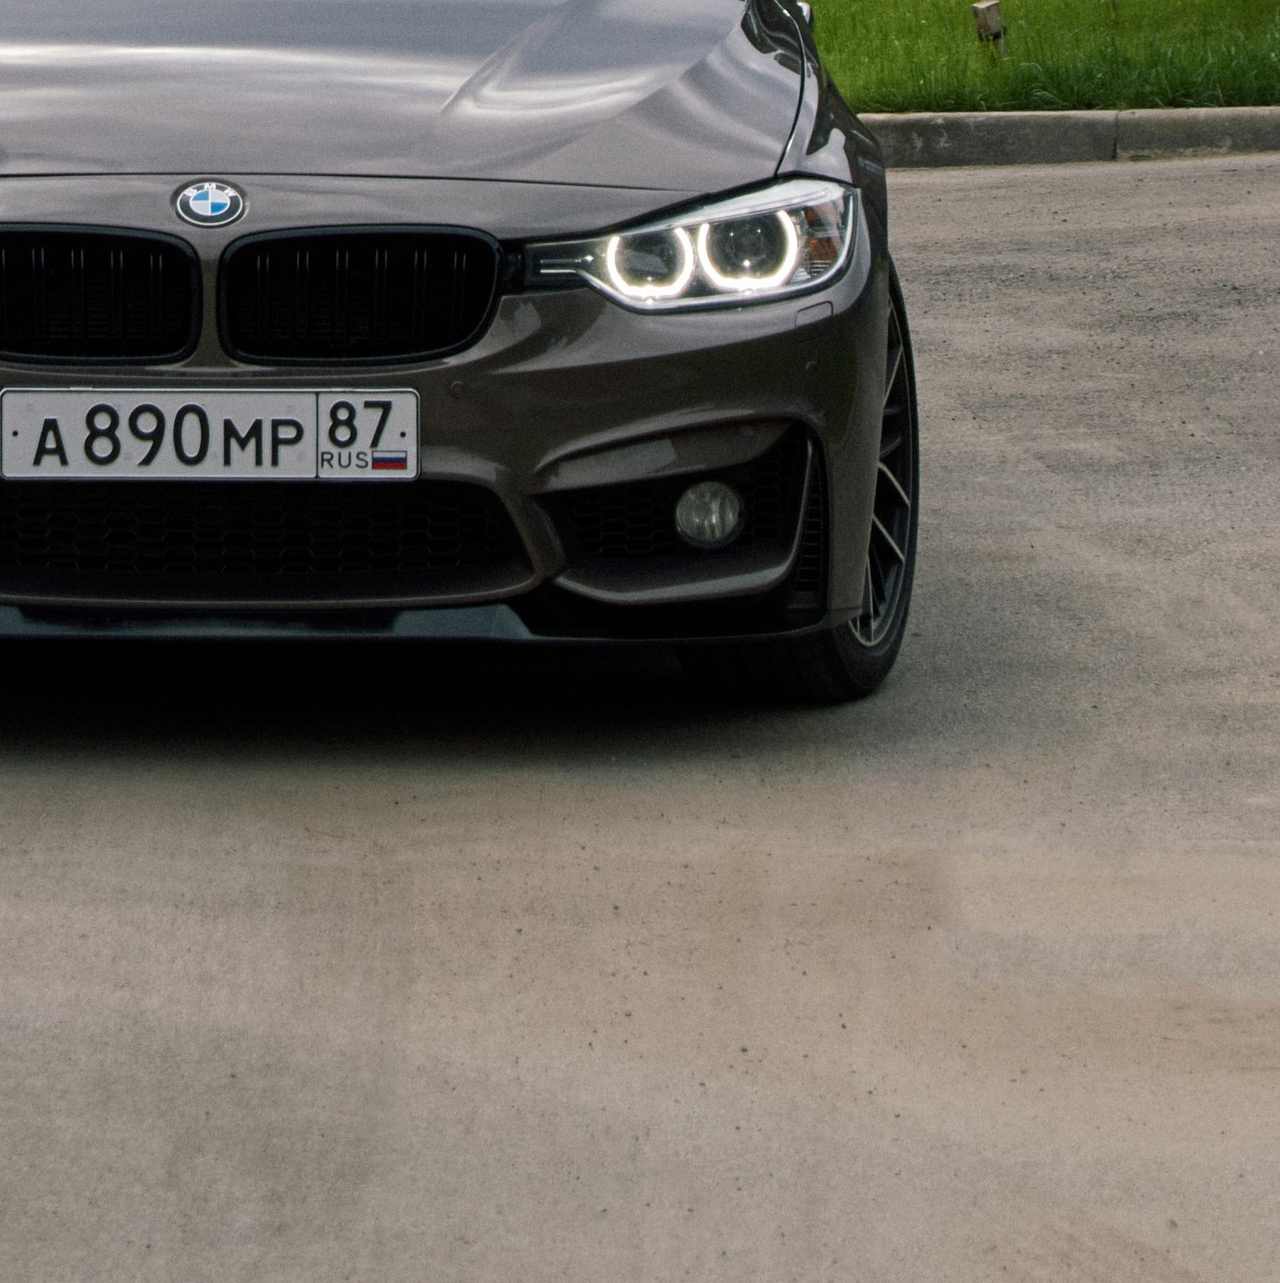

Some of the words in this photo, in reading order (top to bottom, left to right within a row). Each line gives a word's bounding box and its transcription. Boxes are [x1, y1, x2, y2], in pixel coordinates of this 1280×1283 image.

[184, 183, 236, 196] BMW
[328, 400, 393, 449] 87
[321, 451, 369, 469] RUS
